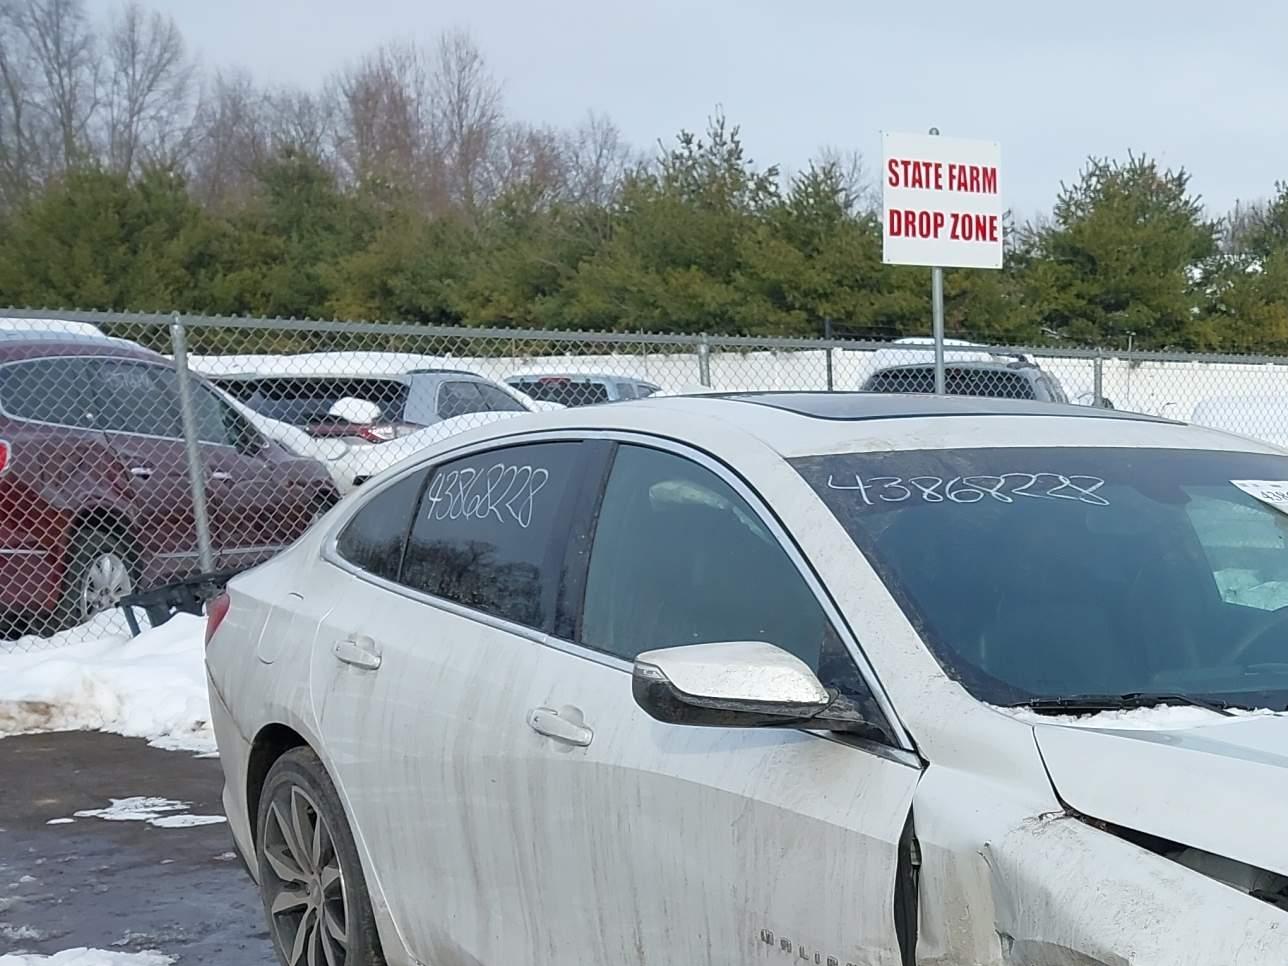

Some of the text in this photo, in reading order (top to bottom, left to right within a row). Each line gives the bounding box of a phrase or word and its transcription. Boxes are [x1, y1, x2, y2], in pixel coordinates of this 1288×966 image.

[888, 158, 998, 195] STATE FARM
[889, 208, 998, 242] DROP ZONE
[427, 463, 549, 529] 43868228
[827, 472, 1110, 505] 43868228
